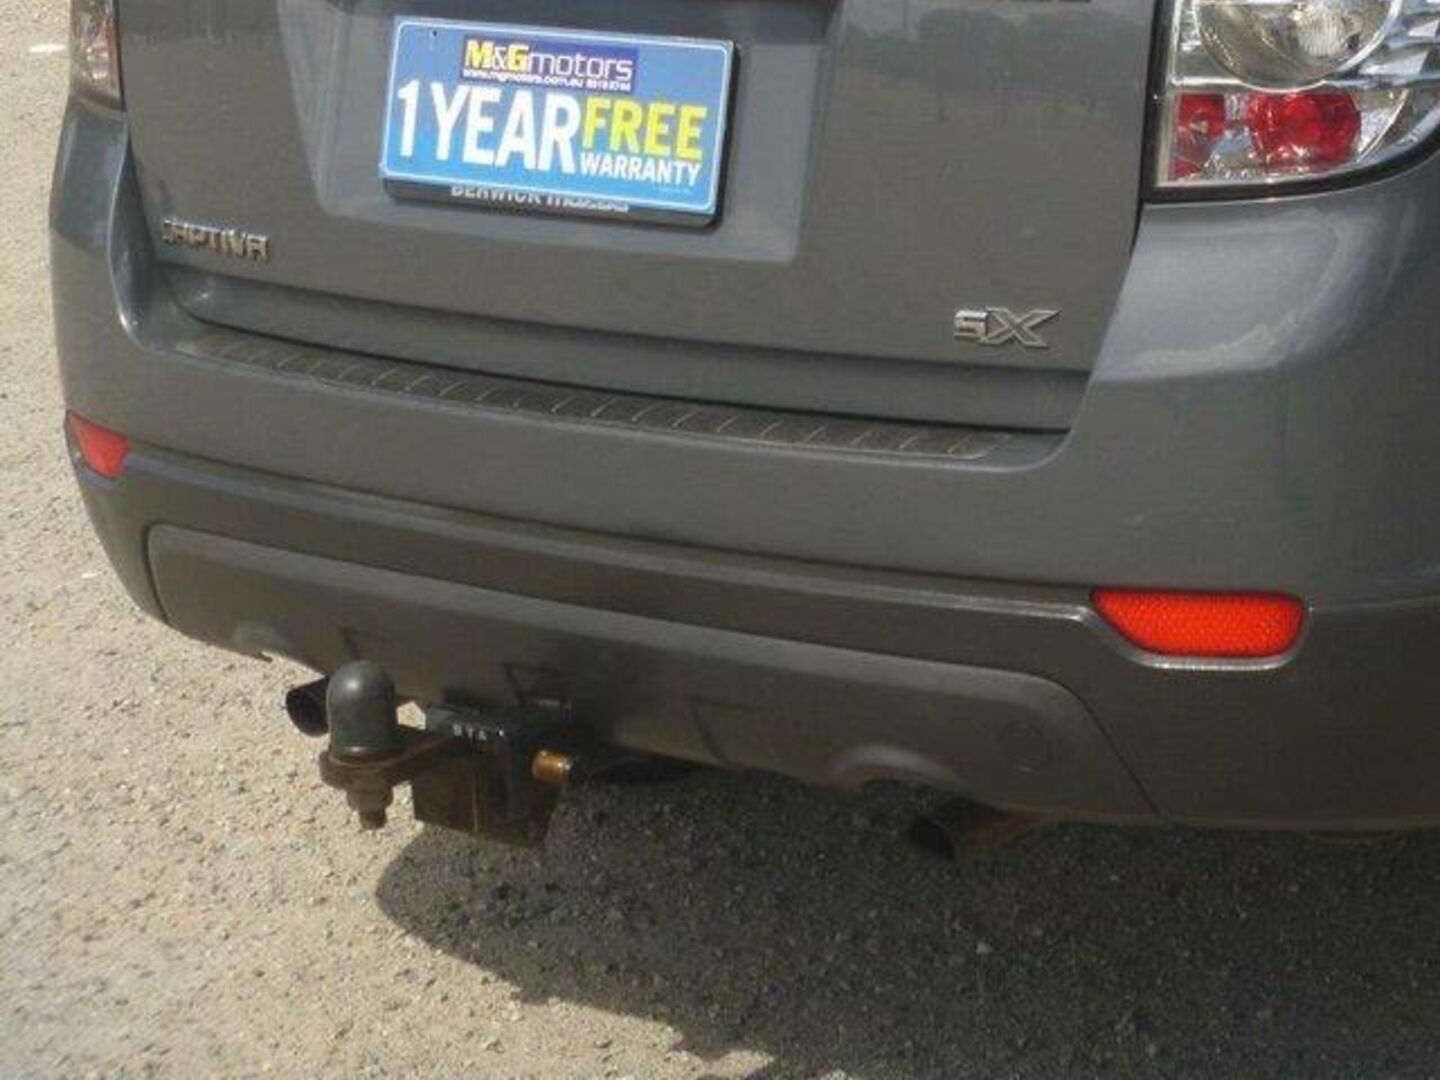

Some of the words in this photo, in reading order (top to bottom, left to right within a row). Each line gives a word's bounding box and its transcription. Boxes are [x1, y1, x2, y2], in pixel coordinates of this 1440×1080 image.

[397, 79, 421, 158] 1
[429, 81, 583, 175] YEAR
[581, 96, 709, 161] FREE
[579, 152, 702, 187] WARRANTY
[952, 306, 1062, 349] SX
